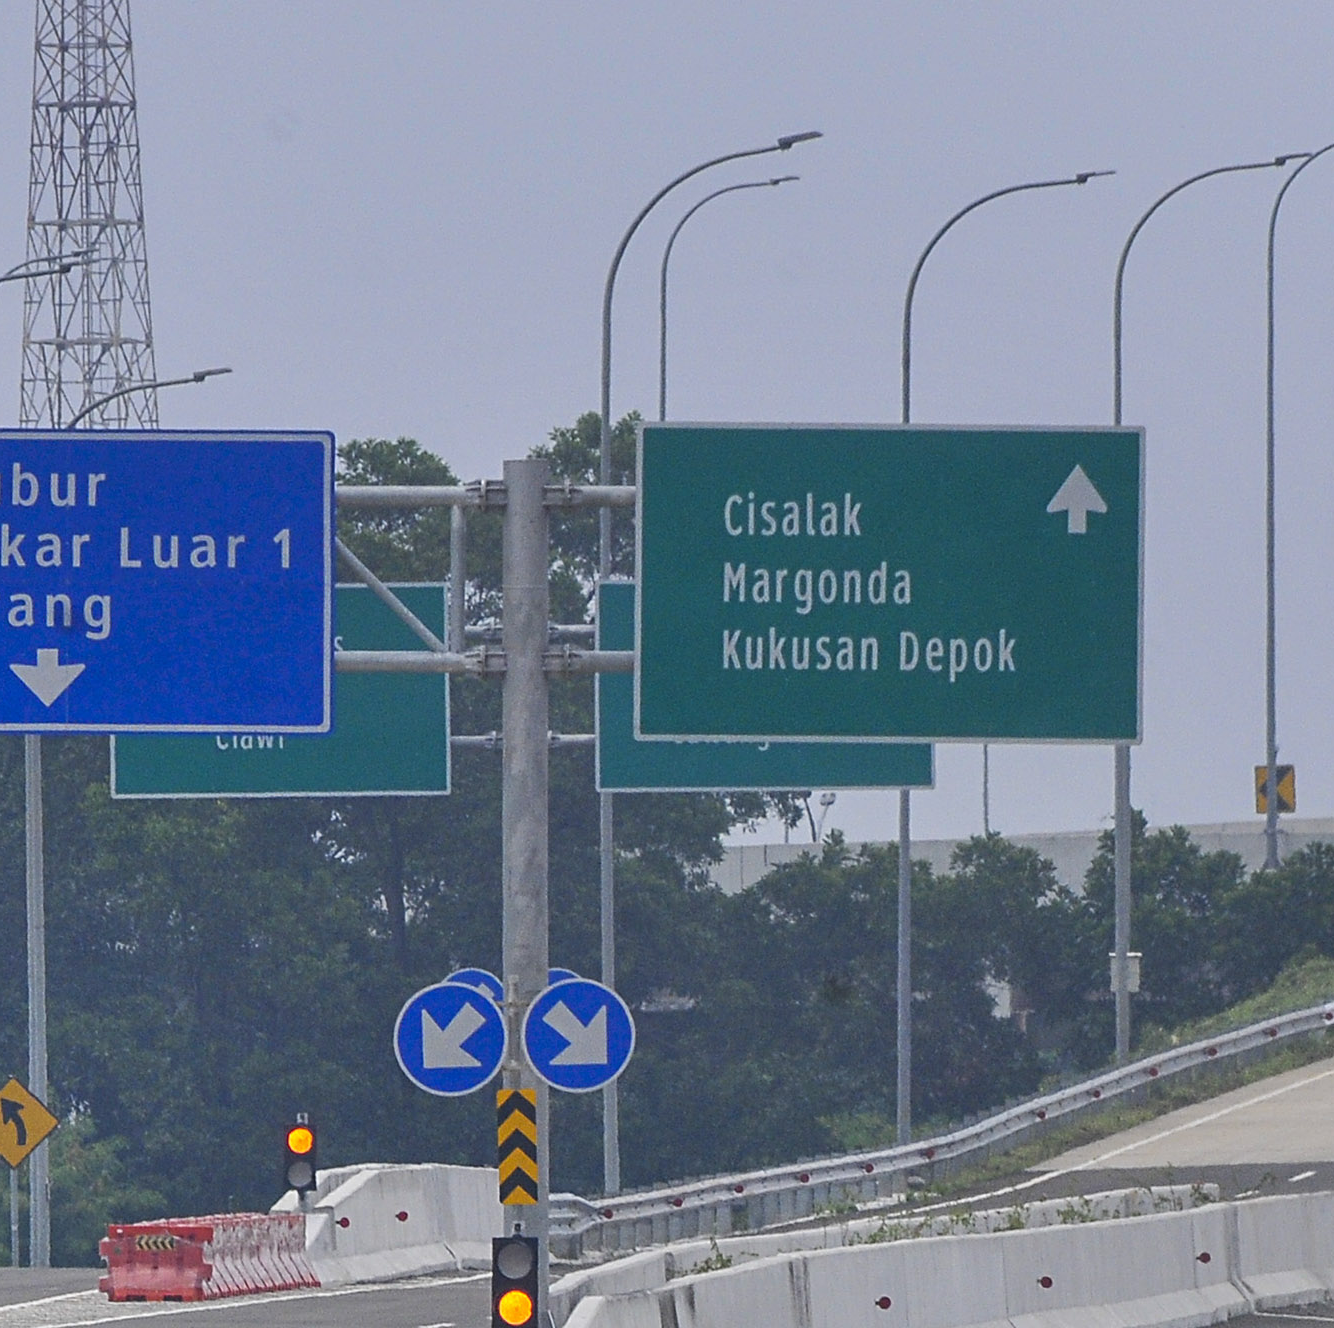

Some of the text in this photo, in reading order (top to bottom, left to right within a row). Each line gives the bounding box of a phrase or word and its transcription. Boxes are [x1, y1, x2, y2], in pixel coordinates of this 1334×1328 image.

[723, 491, 863, 537] Cisalak
[120, 526, 247, 569] Luar
[273, 528, 291, 569] 1
[723, 561, 912, 615] Margonda
[723, 626, 1017, 683] Kukusan Depok
